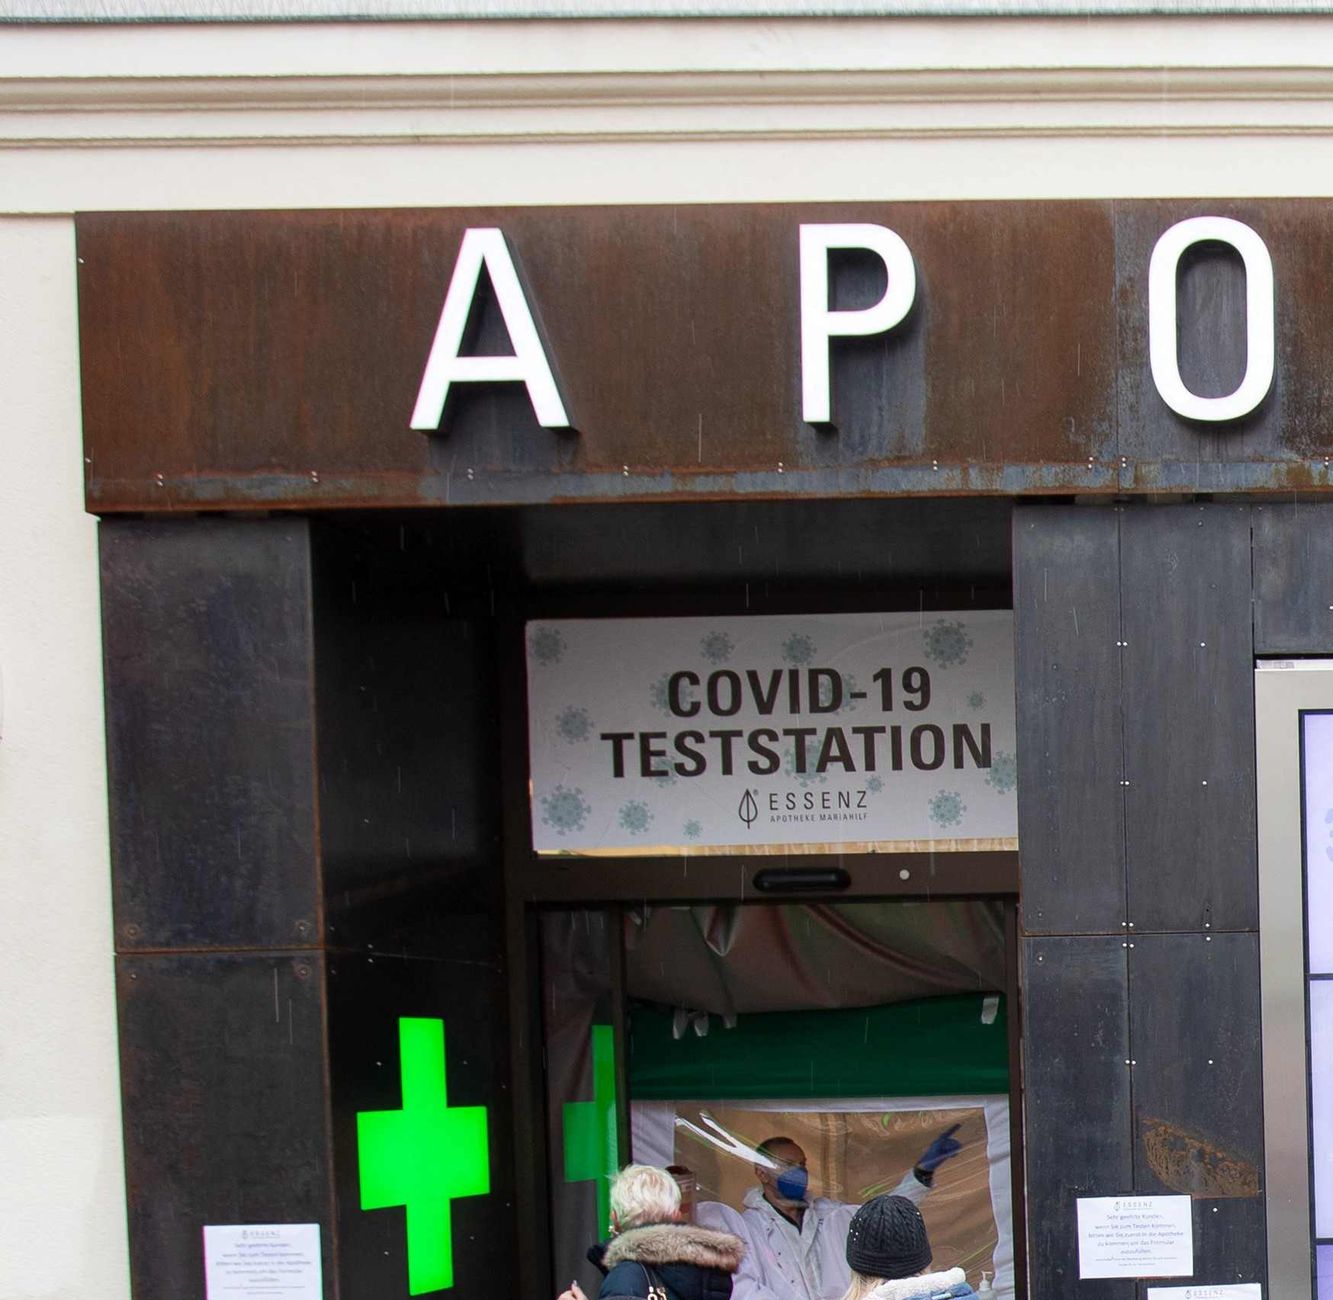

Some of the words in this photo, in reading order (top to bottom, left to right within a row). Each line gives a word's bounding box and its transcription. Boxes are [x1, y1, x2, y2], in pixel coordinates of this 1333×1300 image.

[667, 666, 931, 718] COVID-19
[600, 723, 992, 778] TESTSTATION
[769, 790, 868, 811] ESSENZ
[770, 813, 815, 823] APOTHEKE
[819, 812, 868, 822] MARIAHILF
